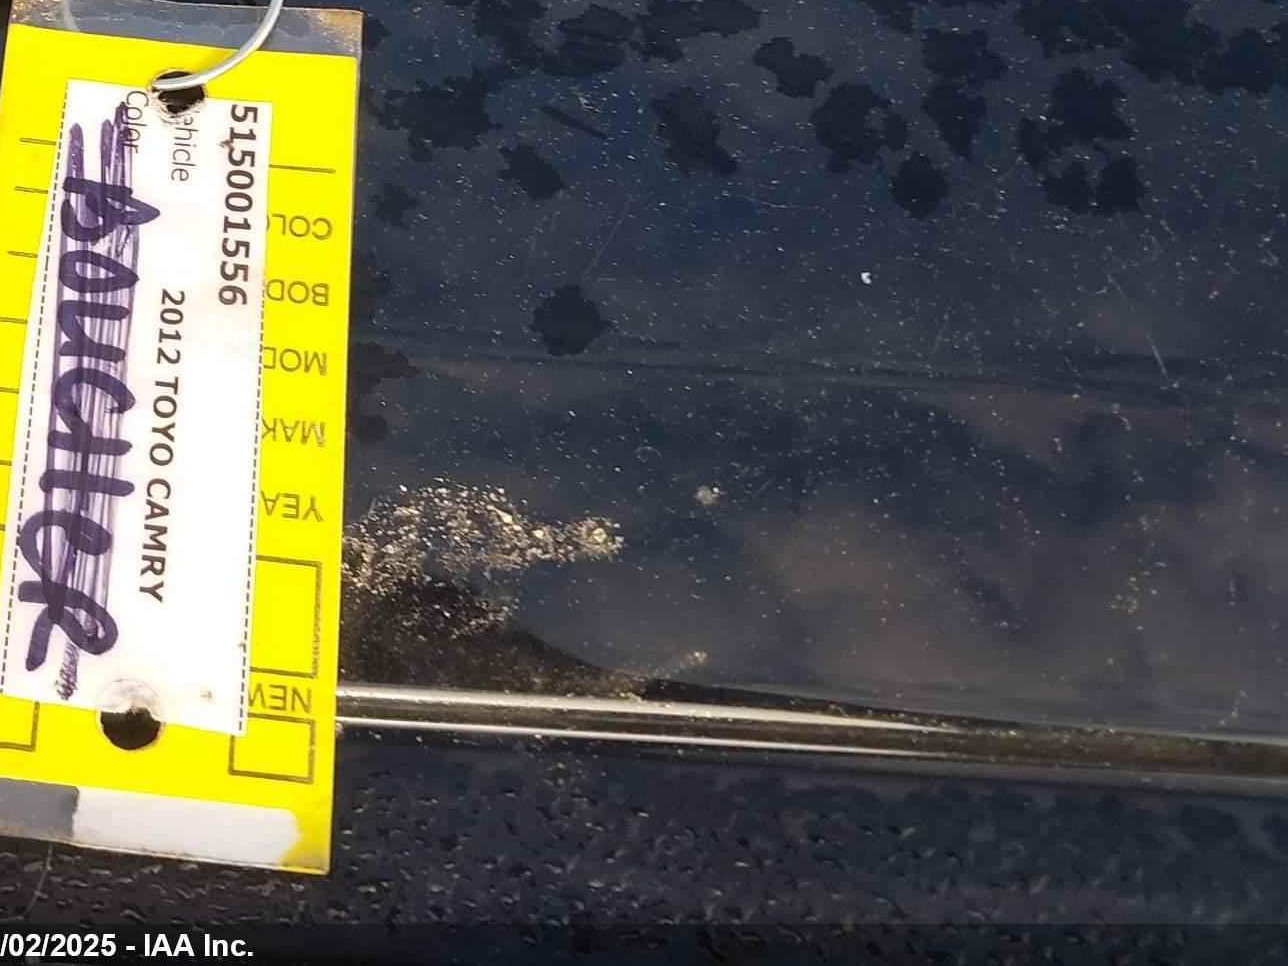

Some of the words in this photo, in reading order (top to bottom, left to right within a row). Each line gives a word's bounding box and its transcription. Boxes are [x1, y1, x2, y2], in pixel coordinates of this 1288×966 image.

[120, 90, 150, 154] Color
[218, 103, 259, 306] 515001556
[266, 212, 333, 241] COL
[155, 288, 186, 365] 2012
[148, 376, 180, 467] TOYO
[138, 477, 172, 604] CAMRY
